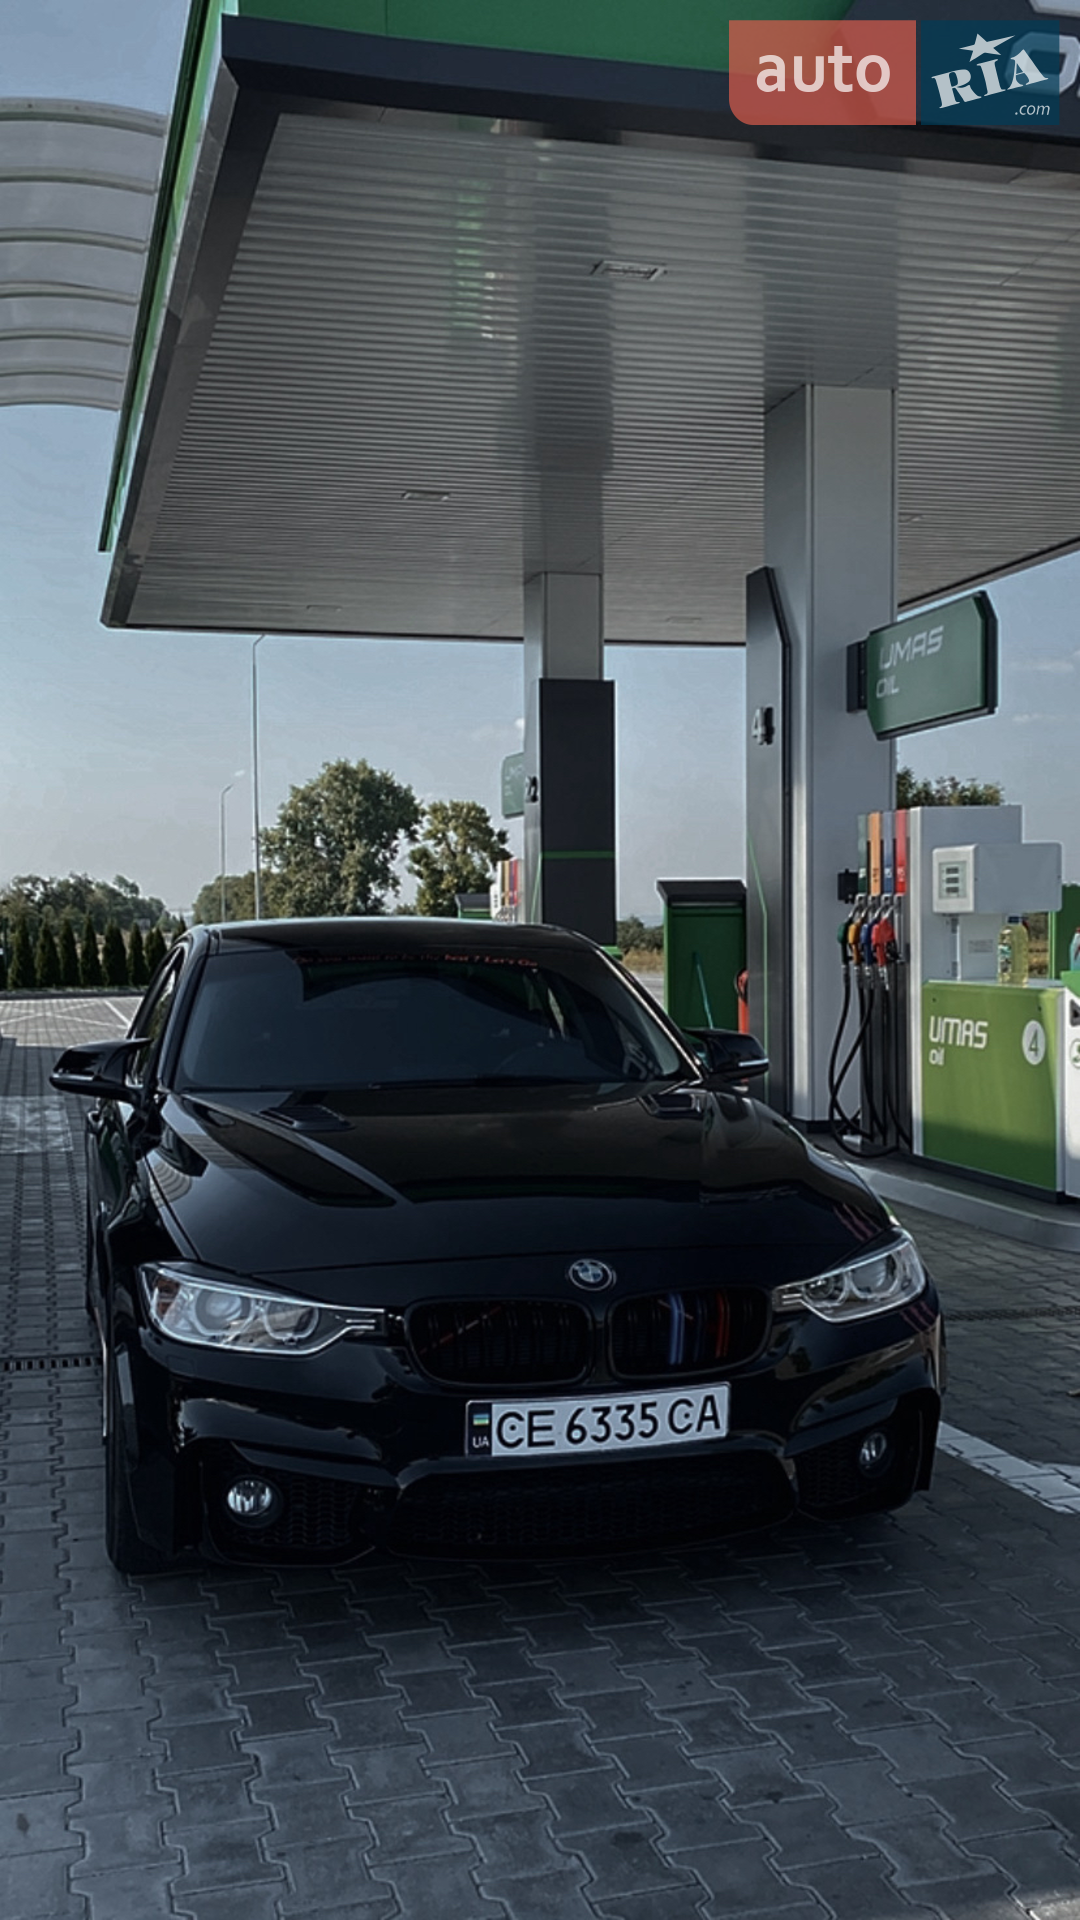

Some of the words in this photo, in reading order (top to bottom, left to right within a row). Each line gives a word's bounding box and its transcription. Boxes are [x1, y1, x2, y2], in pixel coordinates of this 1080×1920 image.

[879, 625, 944, 670] UMAS
[875, 675, 900, 698] OIL
[929, 1015, 989, 1050] UMAS
[1027, 1028, 1039, 1057] 4
[929, 1046, 945, 1066] oil
[496, 1410, 556, 1449] CE
[566, 1401, 659, 1445] 6335
[668, 1394, 721, 1435] CA
[472, 1435, 489, 1448] UA
